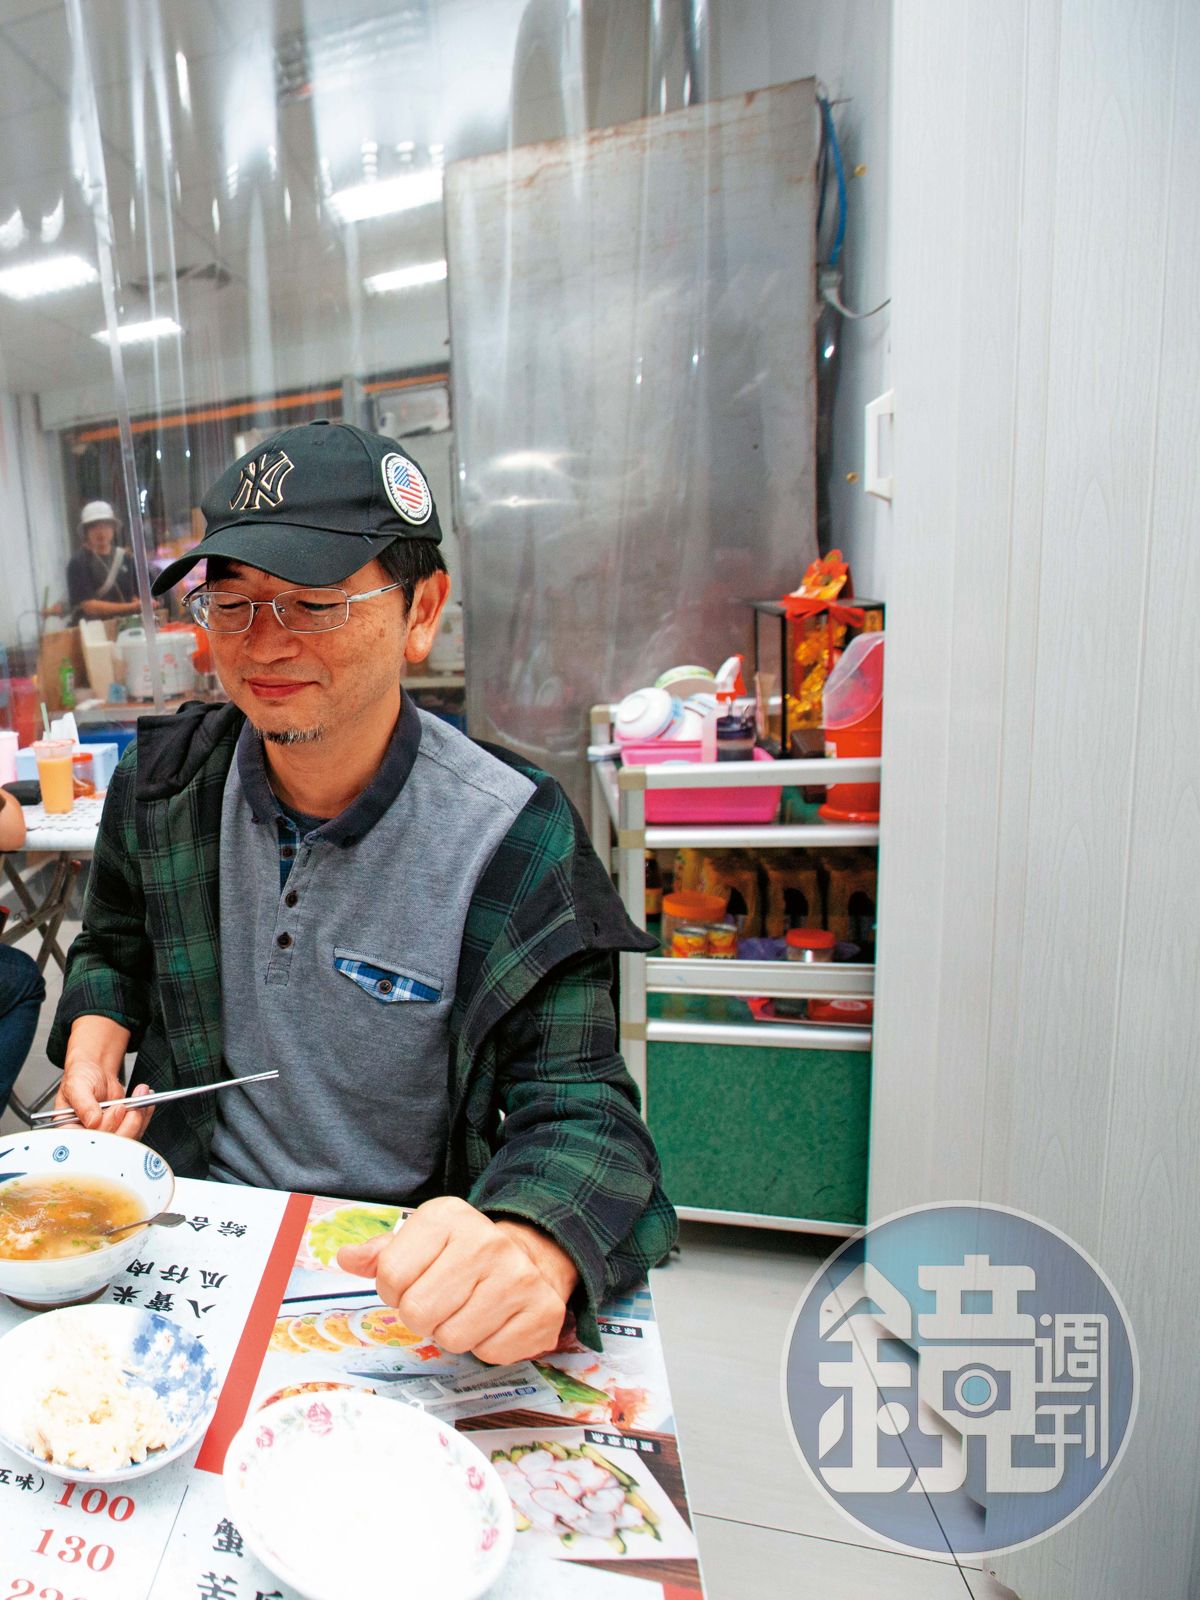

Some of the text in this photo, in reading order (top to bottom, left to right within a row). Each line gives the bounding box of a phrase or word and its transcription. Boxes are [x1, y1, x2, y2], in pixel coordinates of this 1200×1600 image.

[229, 451, 294, 511] NY
[54, 1482, 136, 1522] 100
[31, 1528, 115, 1572] 130
